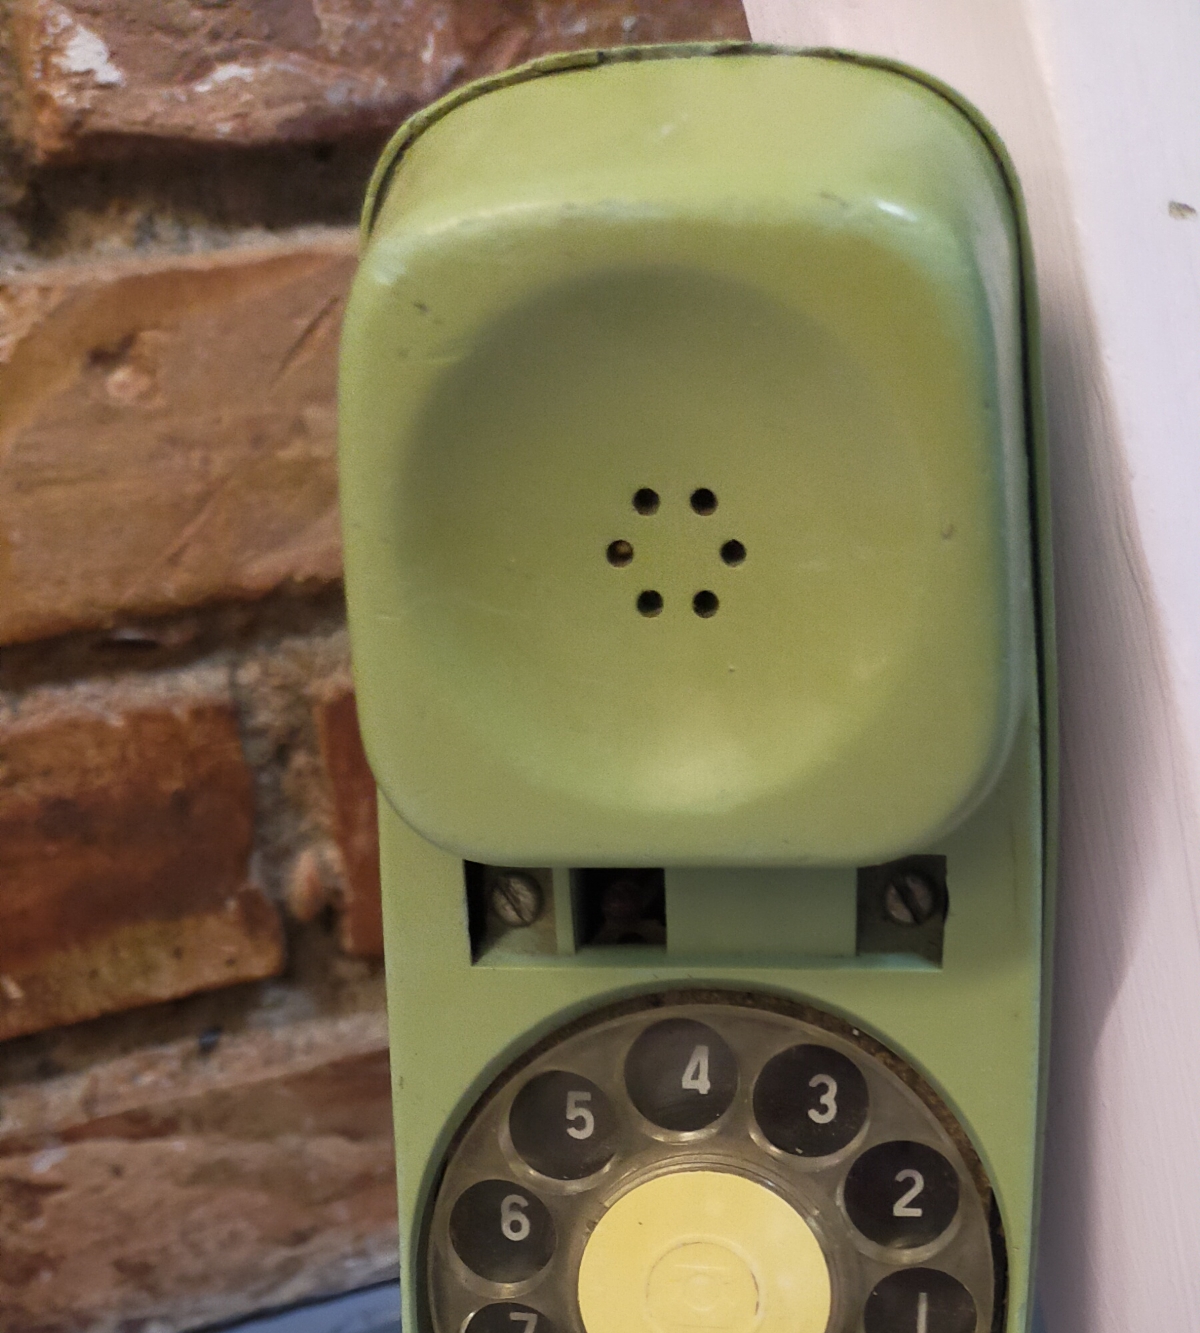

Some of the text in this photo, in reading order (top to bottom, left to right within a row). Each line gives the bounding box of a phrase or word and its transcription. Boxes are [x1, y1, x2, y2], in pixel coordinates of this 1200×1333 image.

[681, 1045, 711, 1095] 4
[566, 1091, 595, 1139] 5
[807, 1074, 838, 1124] 3
[892, 1169, 923, 1217] 2
[501, 1194, 531, 1242] 6
